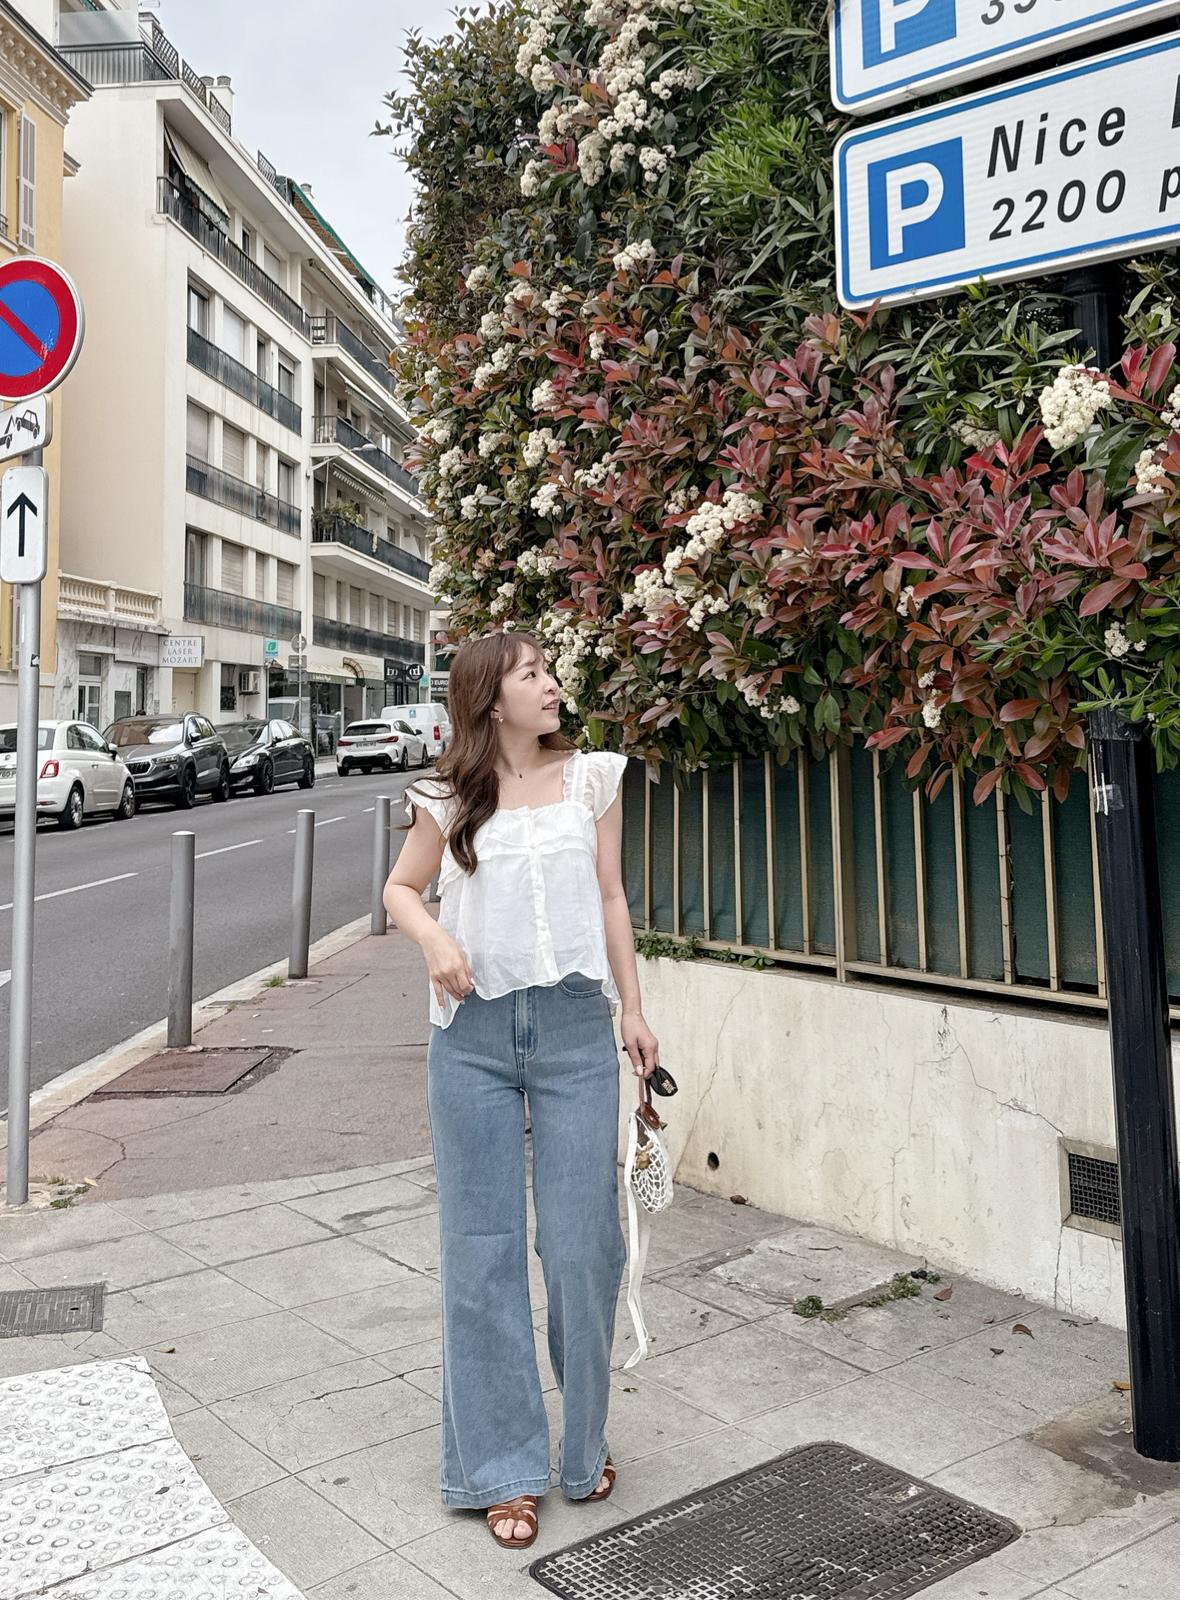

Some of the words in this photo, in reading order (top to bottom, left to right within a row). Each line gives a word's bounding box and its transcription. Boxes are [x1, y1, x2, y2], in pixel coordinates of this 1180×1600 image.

[987, 107, 1126, 178] Nice
[886, 162, 944, 257] P
[989, 169, 1126, 241] 2200
[162, 639, 198, 647] CENTRE
[162, 656, 198, 664] MOZART
